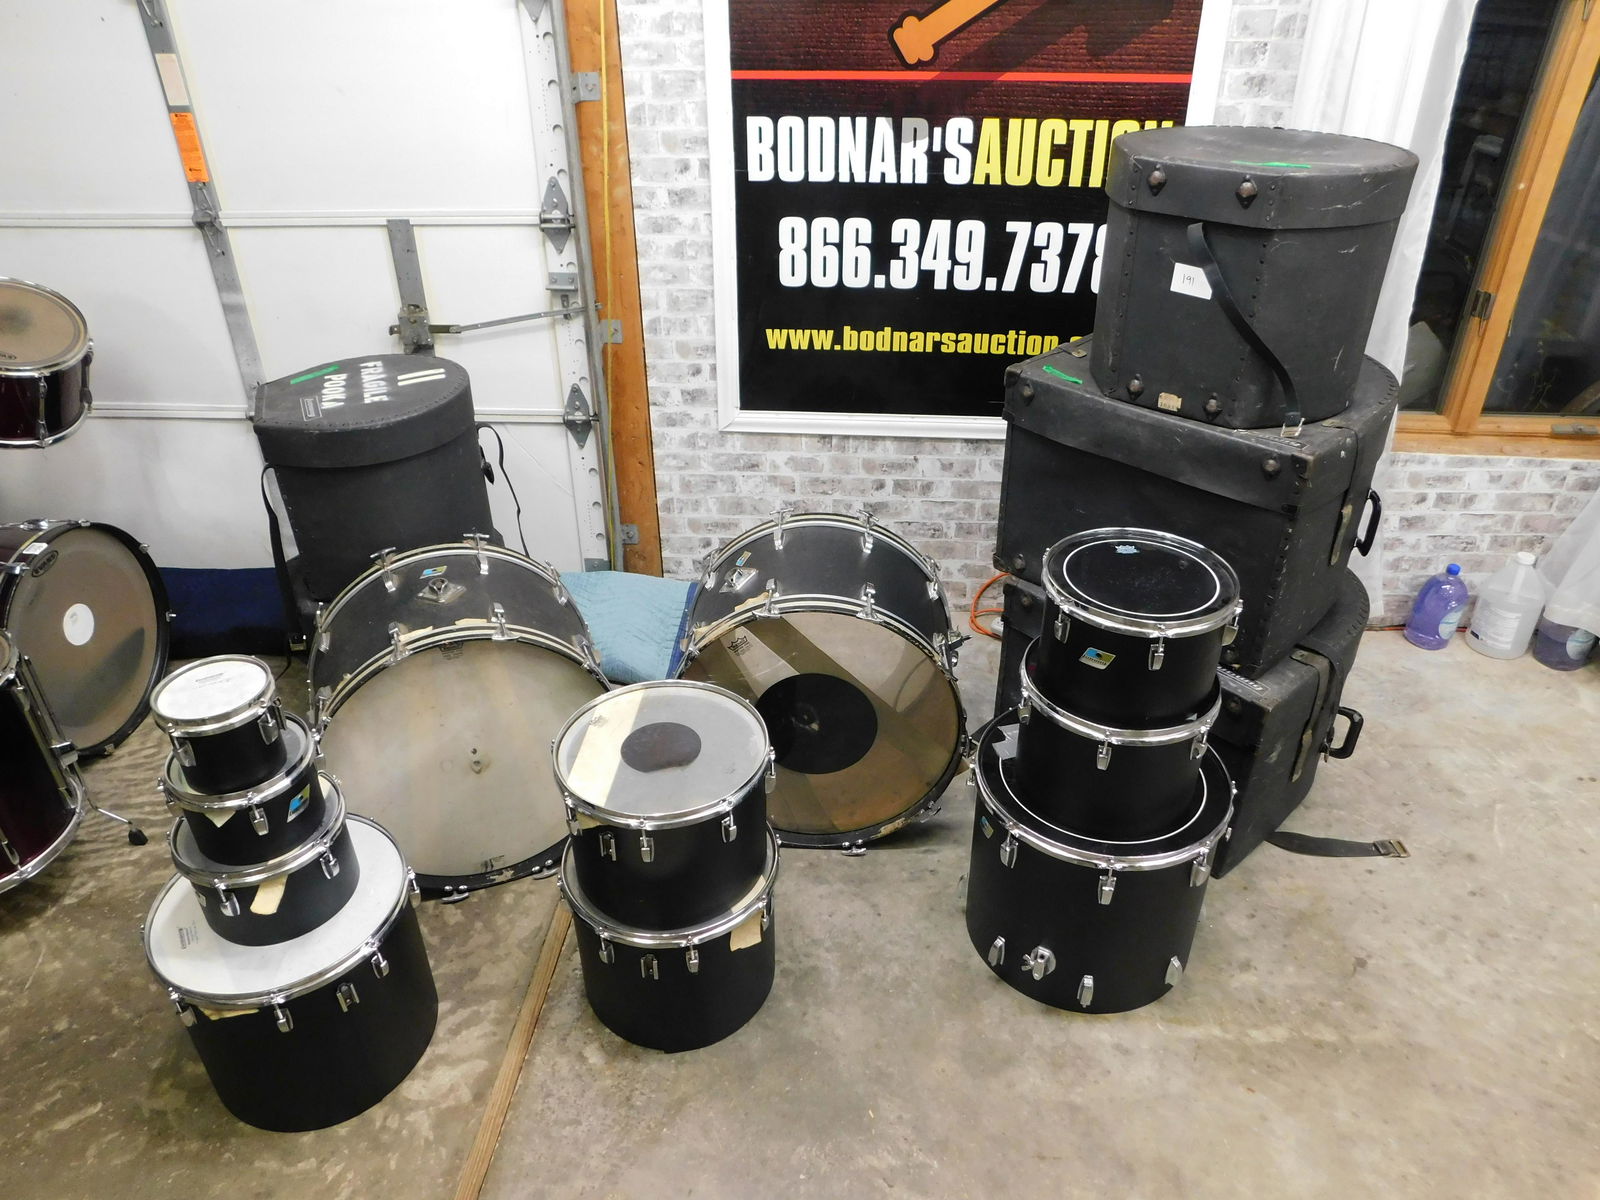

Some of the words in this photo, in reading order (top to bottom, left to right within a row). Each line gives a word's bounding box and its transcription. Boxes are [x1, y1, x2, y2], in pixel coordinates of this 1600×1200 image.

[746, 116, 1174, 188] BODNAR'SAUCTI
[1182, 273, 1195, 287] 191
[765, 326, 1084, 356] www.bodnarsauction
[320, 373, 348, 410] POOKA
[359, 360, 389, 404] FRAGILE
